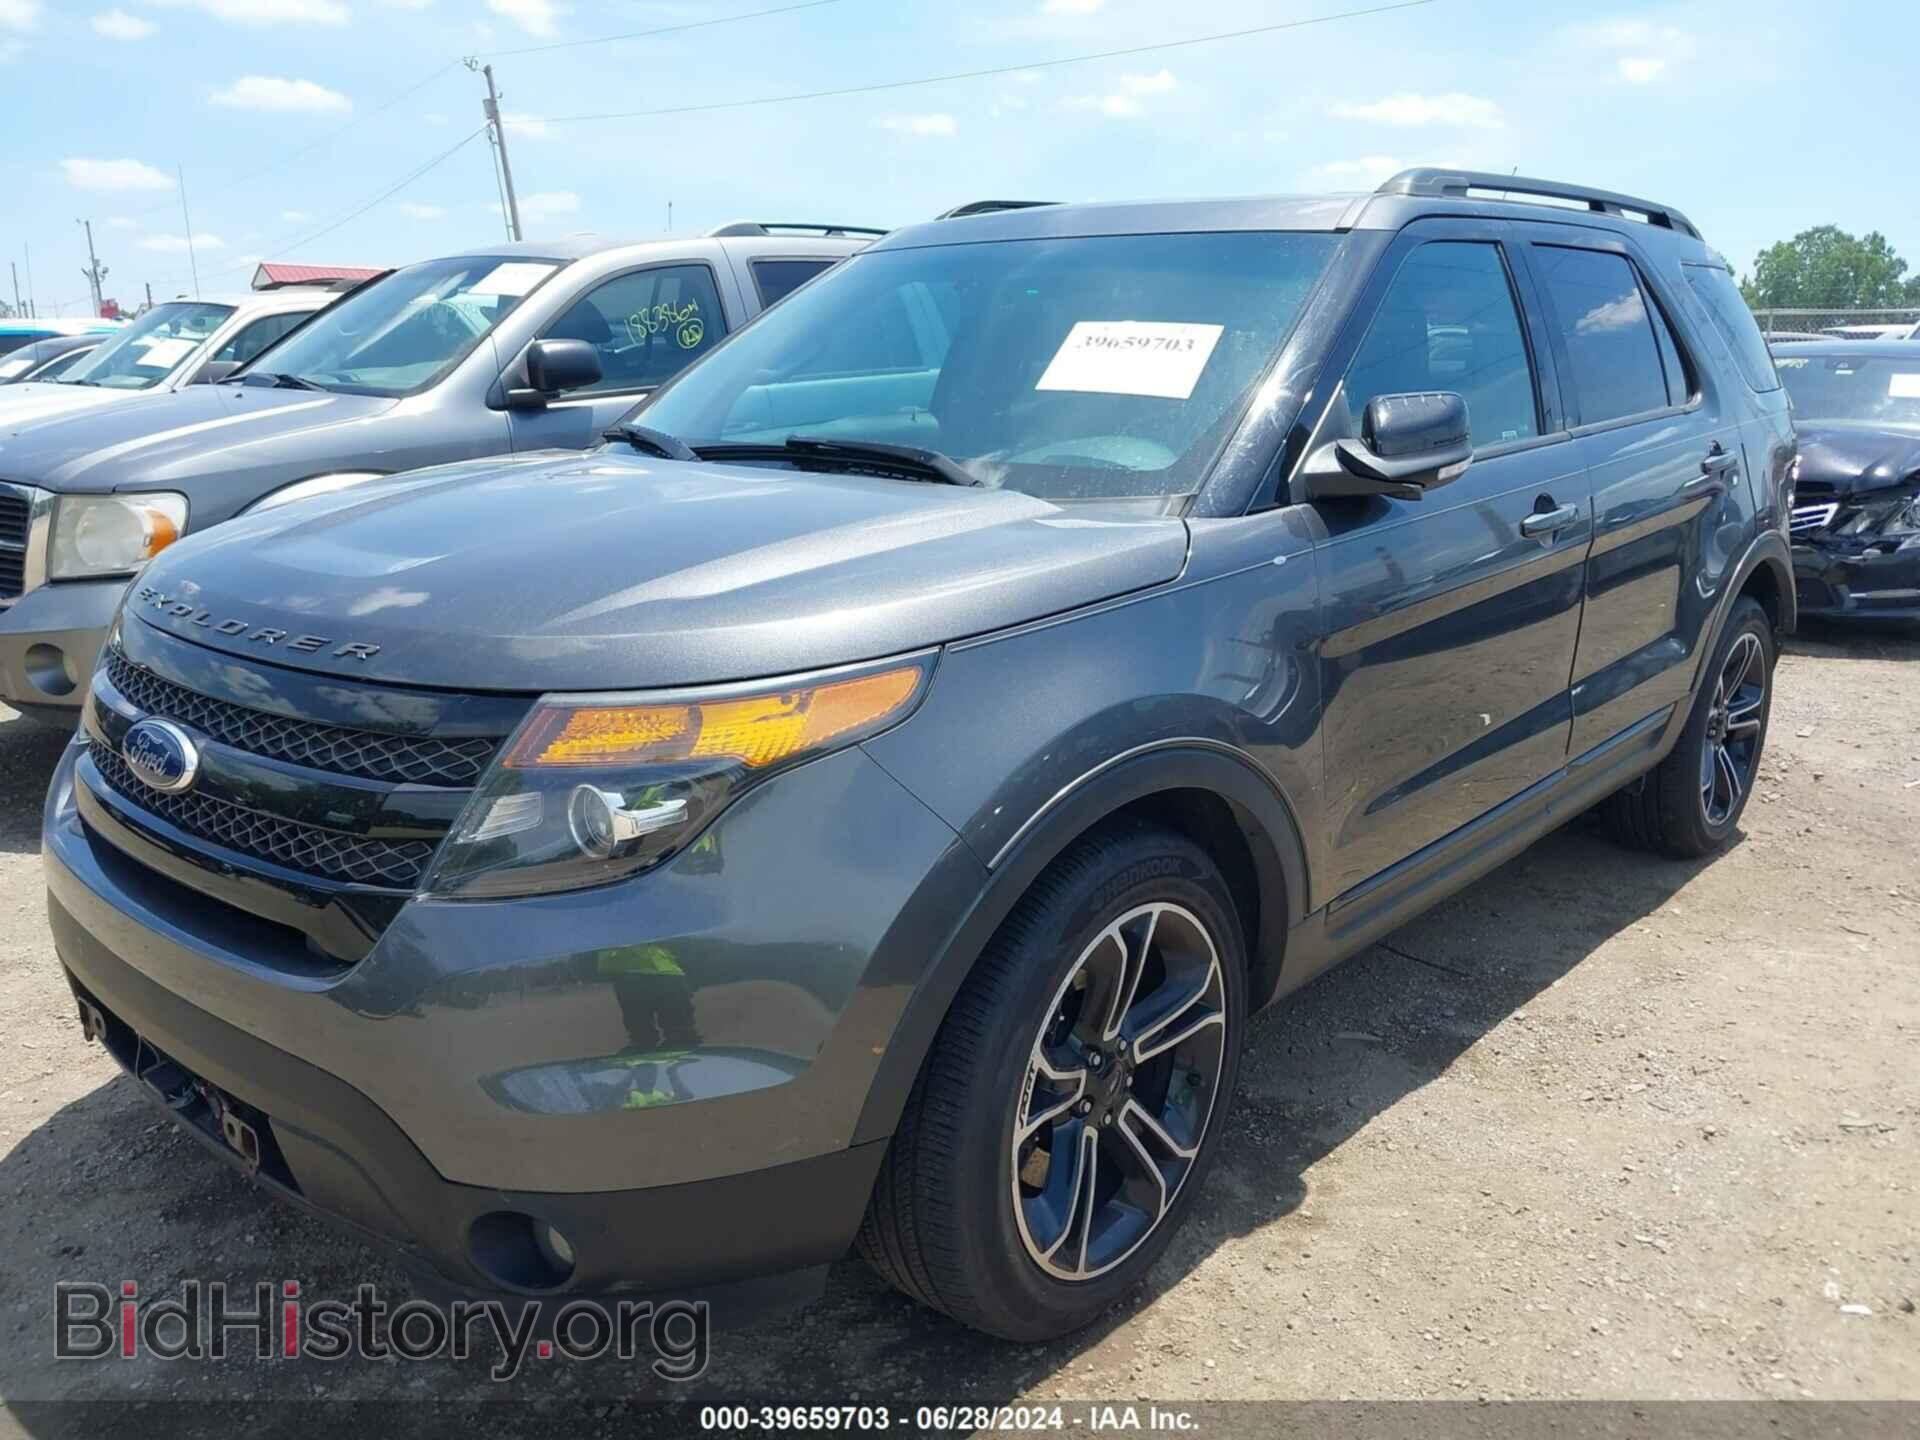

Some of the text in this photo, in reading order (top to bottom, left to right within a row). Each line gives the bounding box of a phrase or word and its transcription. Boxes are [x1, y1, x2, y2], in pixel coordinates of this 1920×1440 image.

[1077, 335, 1195, 352] 39659703
[137, 586, 381, 660] EXPLORER
[129, 730, 169, 777] Ford
